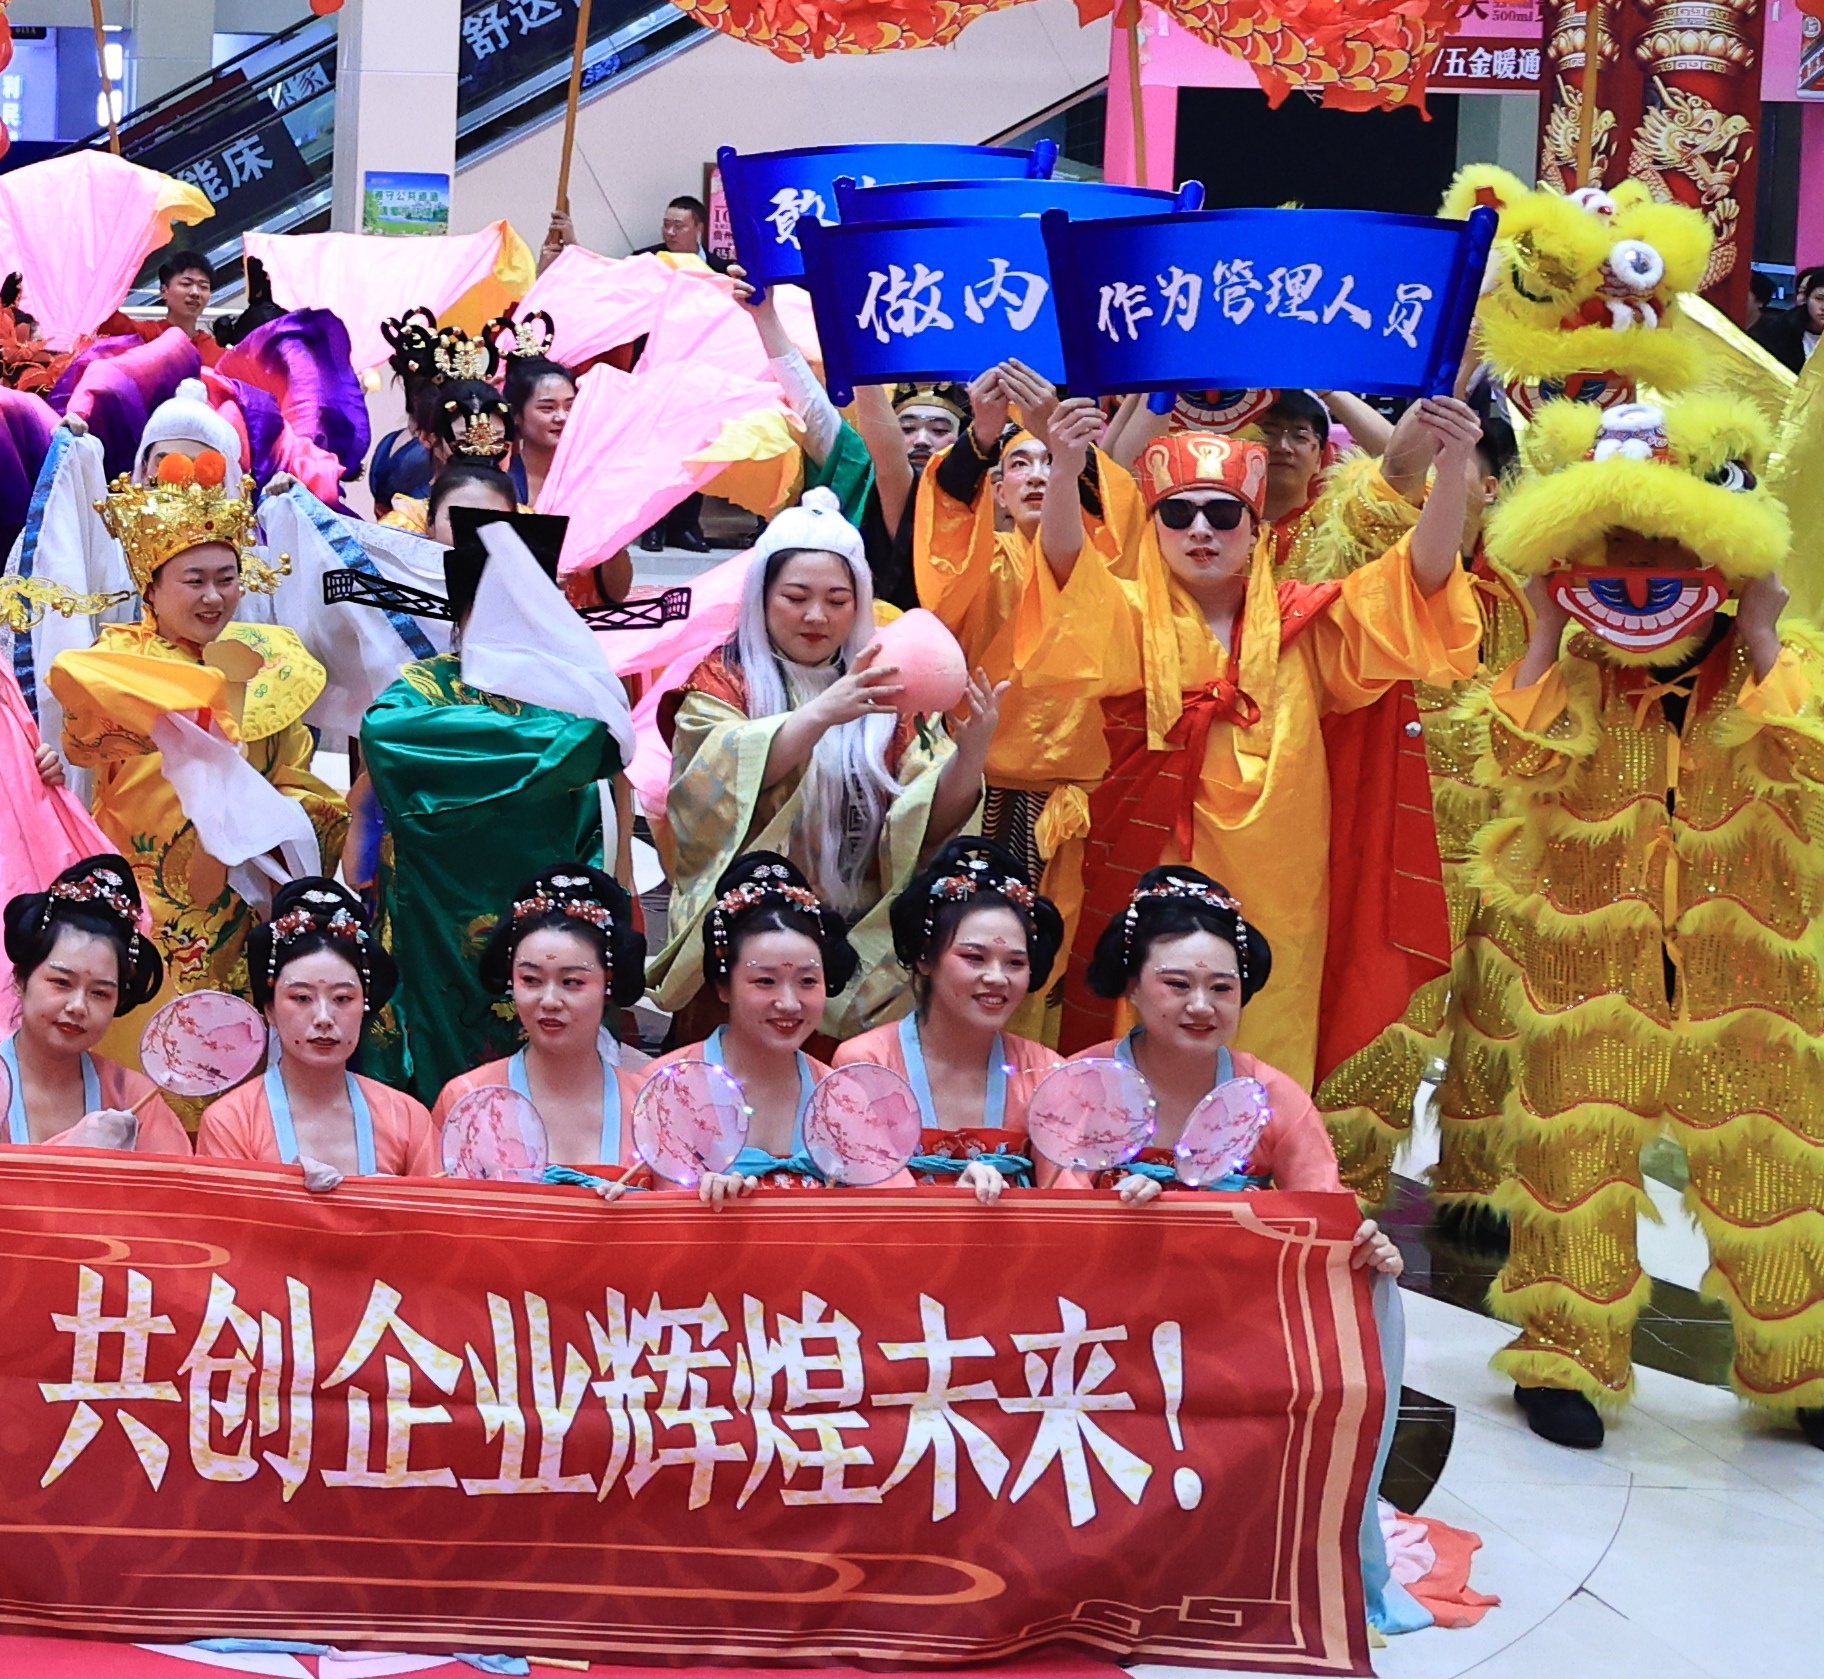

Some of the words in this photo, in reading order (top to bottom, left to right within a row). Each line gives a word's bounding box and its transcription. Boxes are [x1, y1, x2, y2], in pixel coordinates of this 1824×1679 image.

[856, 258, 1049, 344] 做内
[1099, 258, 1434, 349] 作为管理人员
